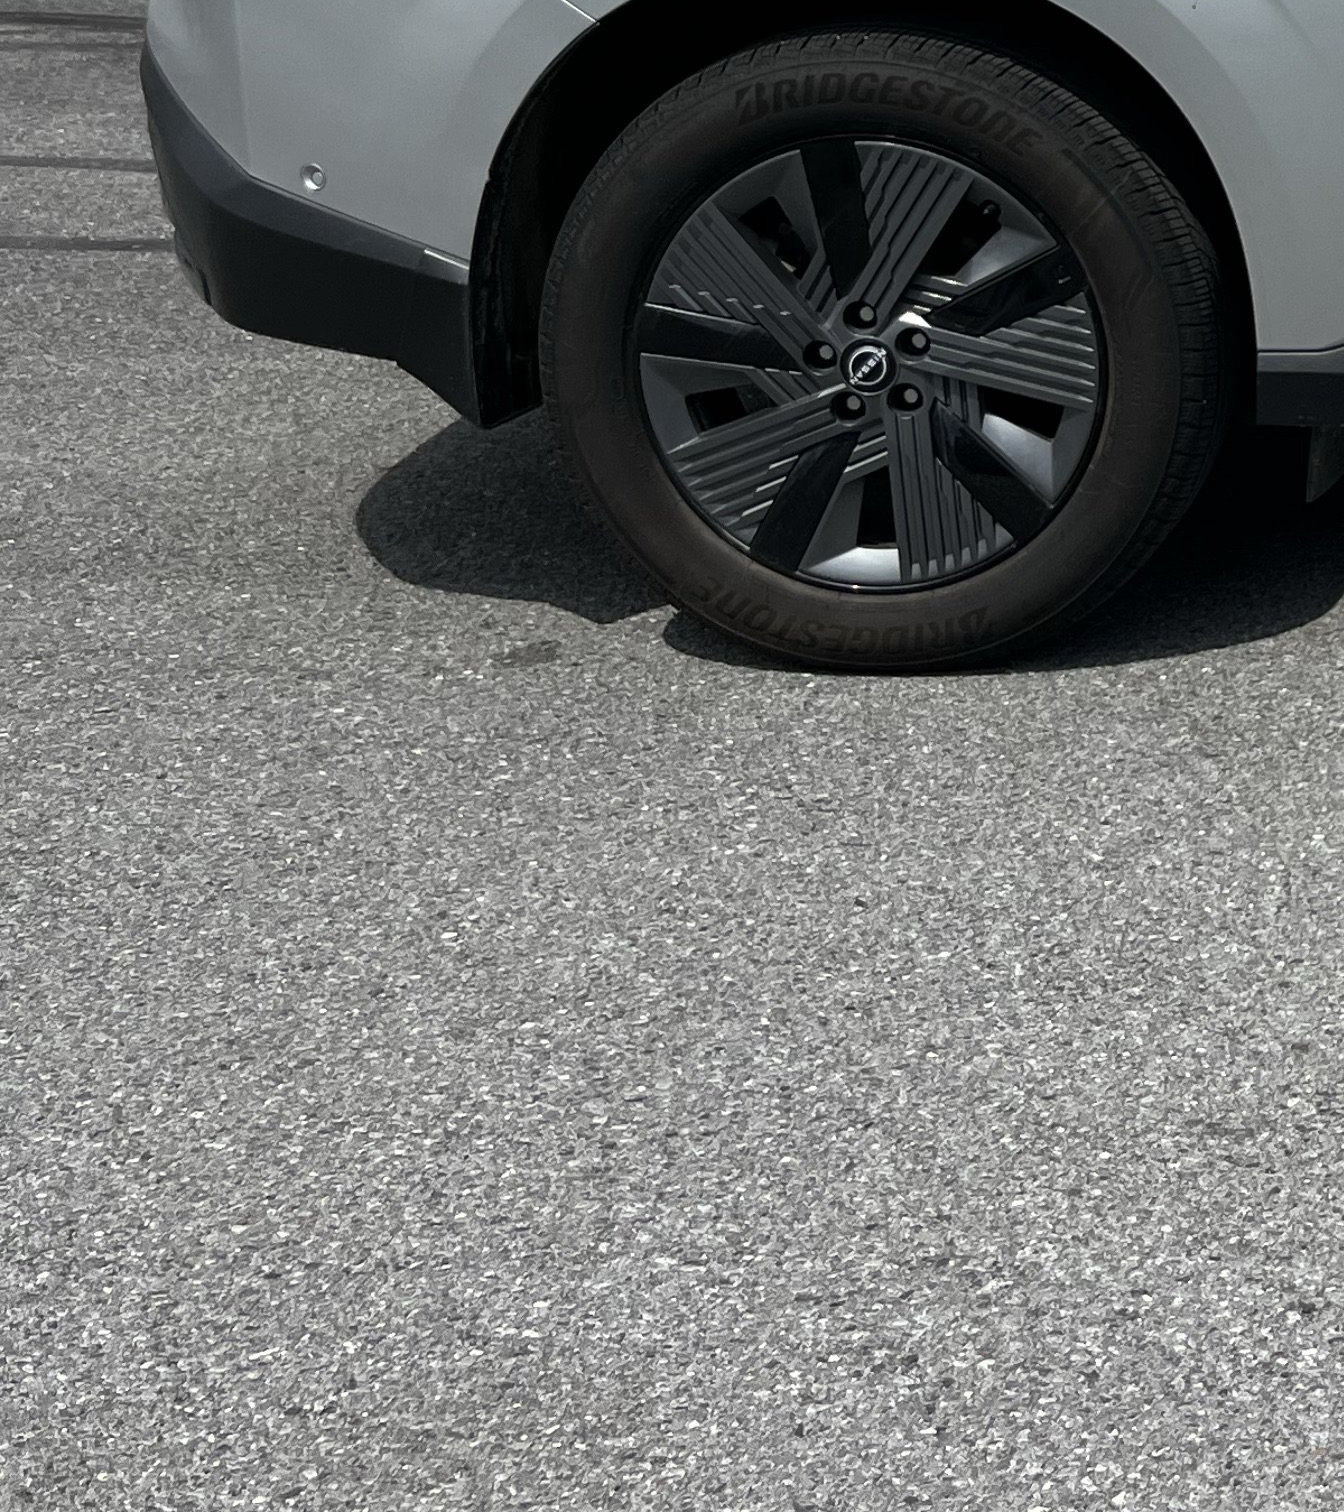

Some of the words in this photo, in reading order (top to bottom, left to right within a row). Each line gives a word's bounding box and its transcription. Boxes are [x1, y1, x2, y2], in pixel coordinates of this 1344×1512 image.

[734, 72, 1044, 157] BRIDGESTONE
[849, 347, 887, 385] NISSAN
[682, 577, 990, 656] BRIDGESTONE
